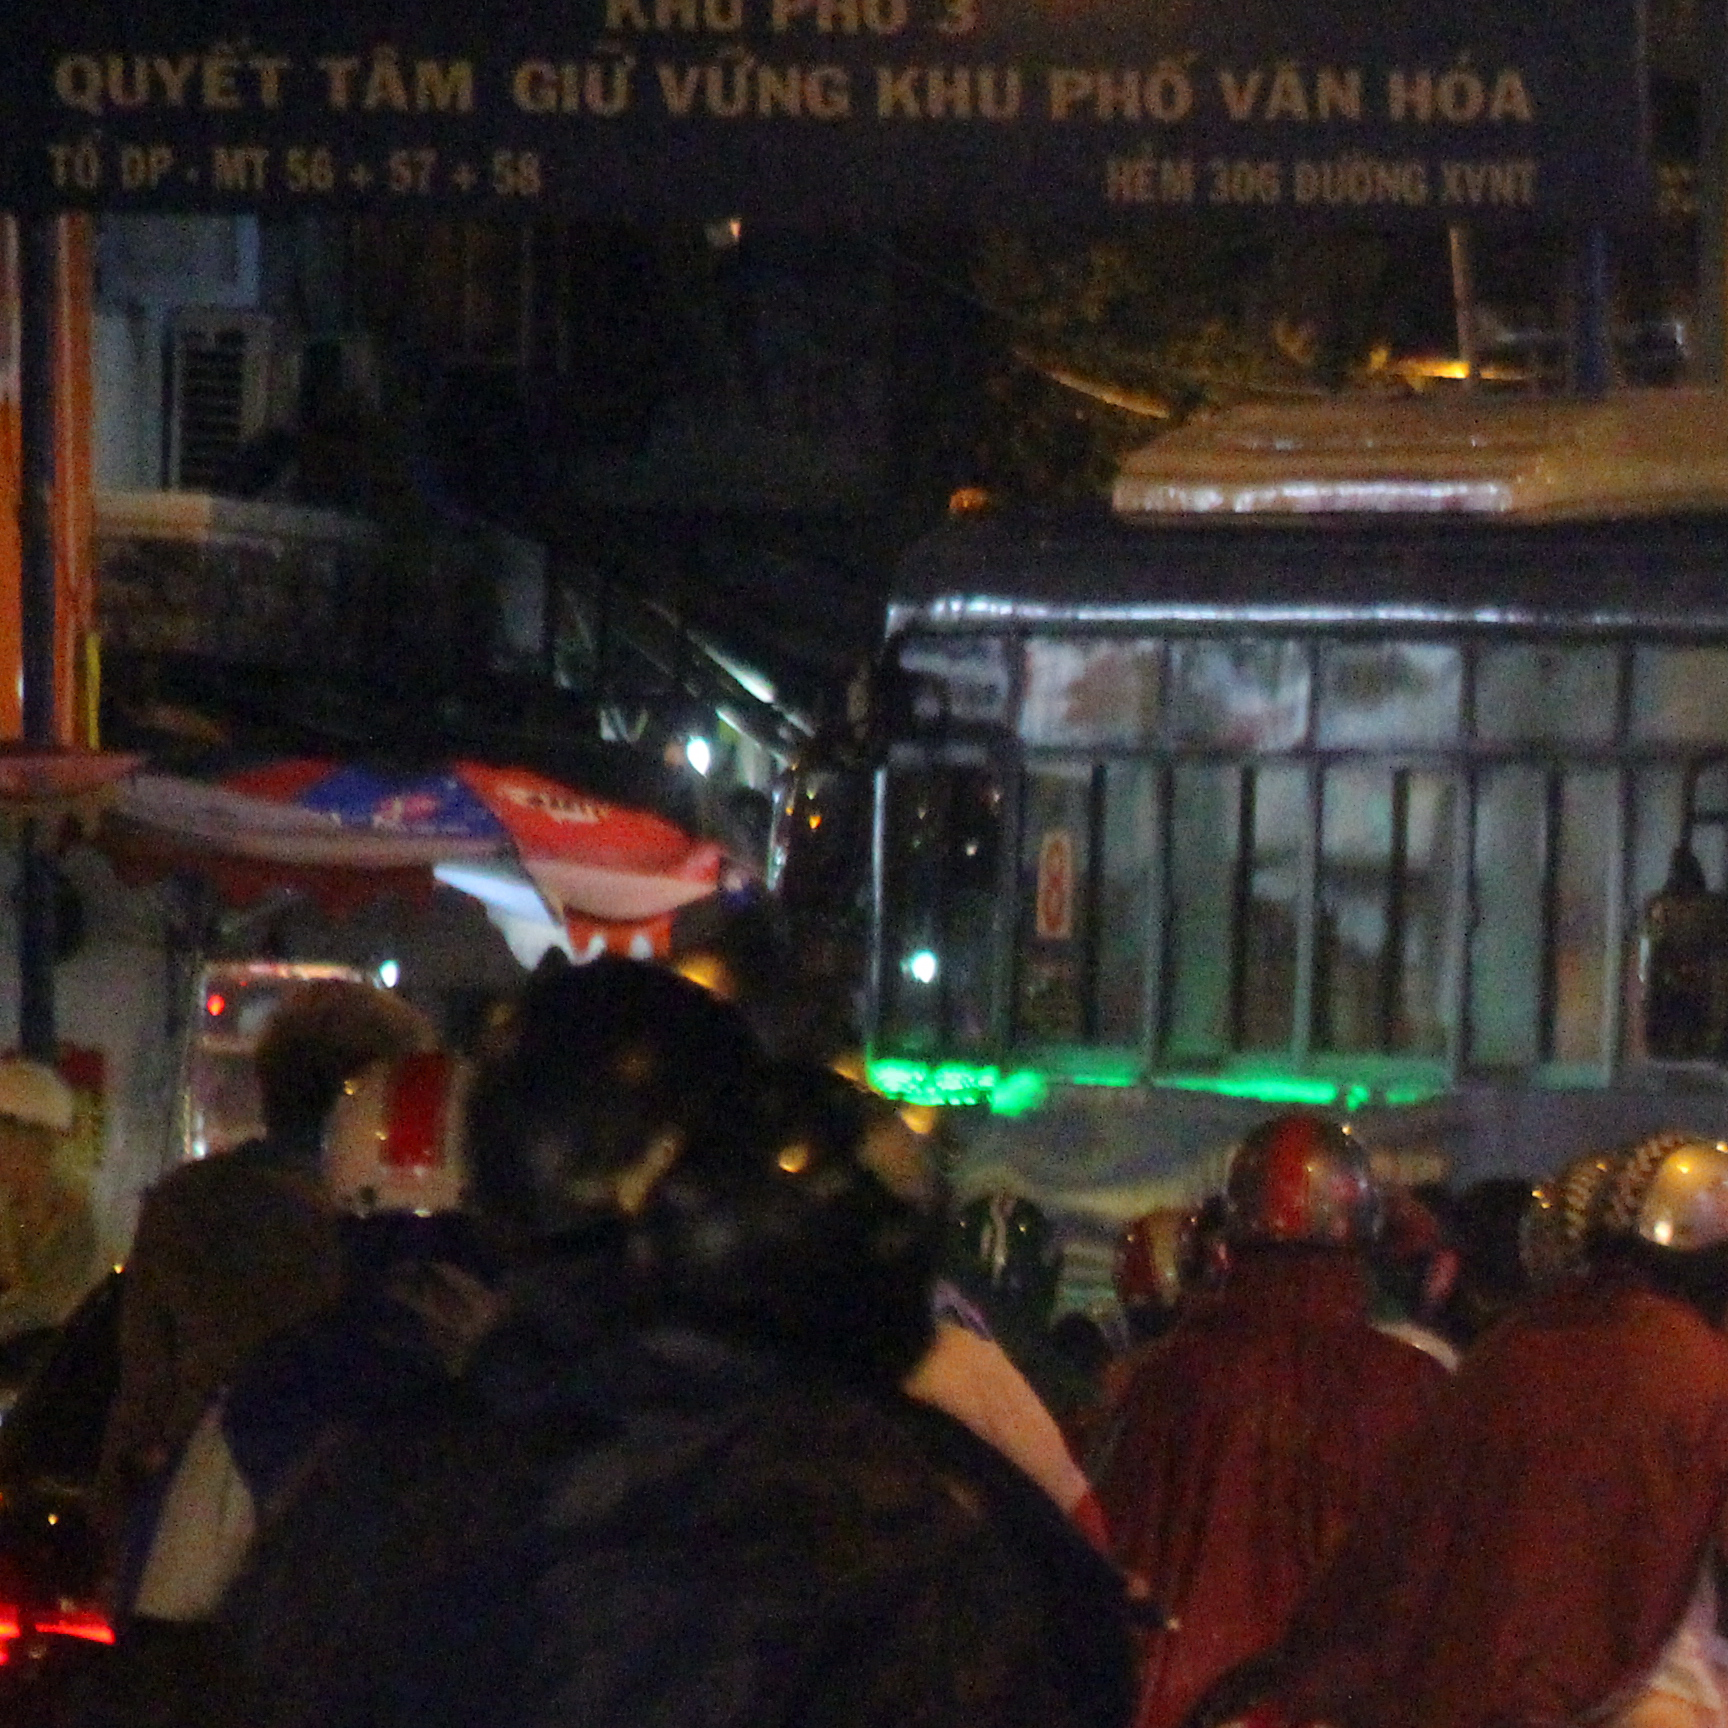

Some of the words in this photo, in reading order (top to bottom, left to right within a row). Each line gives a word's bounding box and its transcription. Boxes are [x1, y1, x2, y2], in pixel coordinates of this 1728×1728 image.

[316, 43, 473, 113] TÂM
[877, 65, 1021, 121] KHU
[1048, 50, 1199, 122] PHỐ
